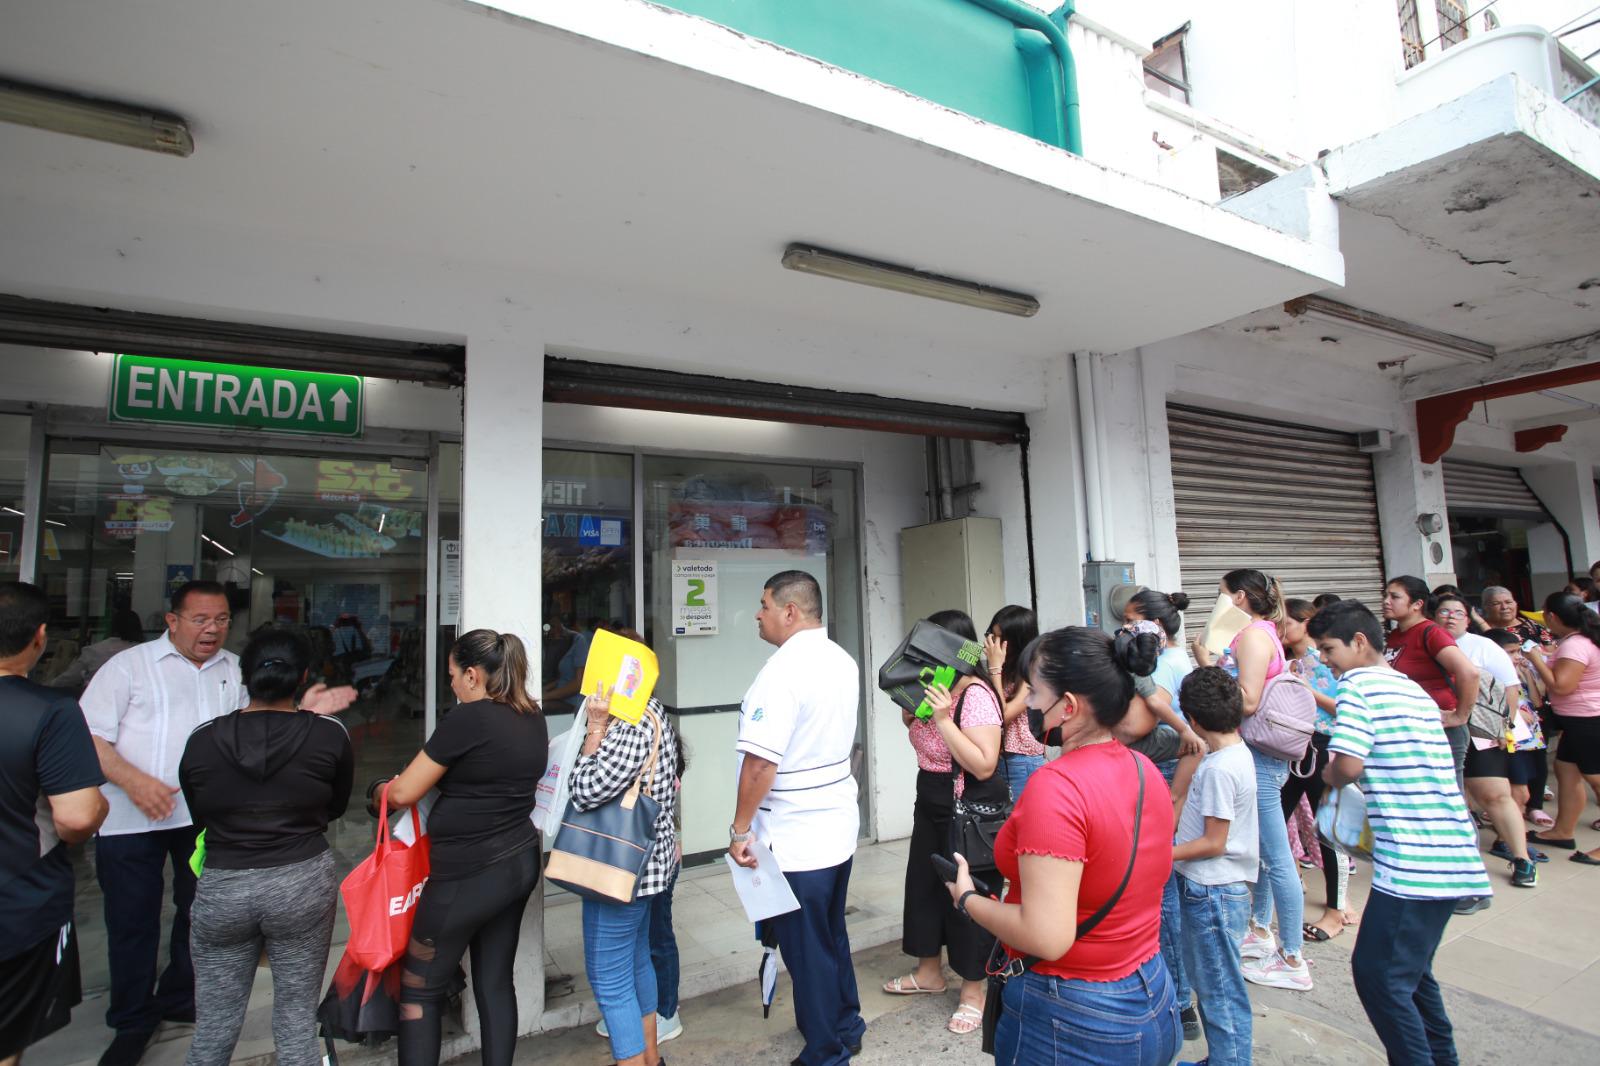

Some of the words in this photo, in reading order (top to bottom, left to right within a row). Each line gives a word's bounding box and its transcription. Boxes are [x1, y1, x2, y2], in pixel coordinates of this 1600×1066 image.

[127, 365, 325, 423] ENTRADA
[583, 529, 600, 537] VISA
[682, 564, 713, 572] valetodo
[687, 578, 705, 606] 2
